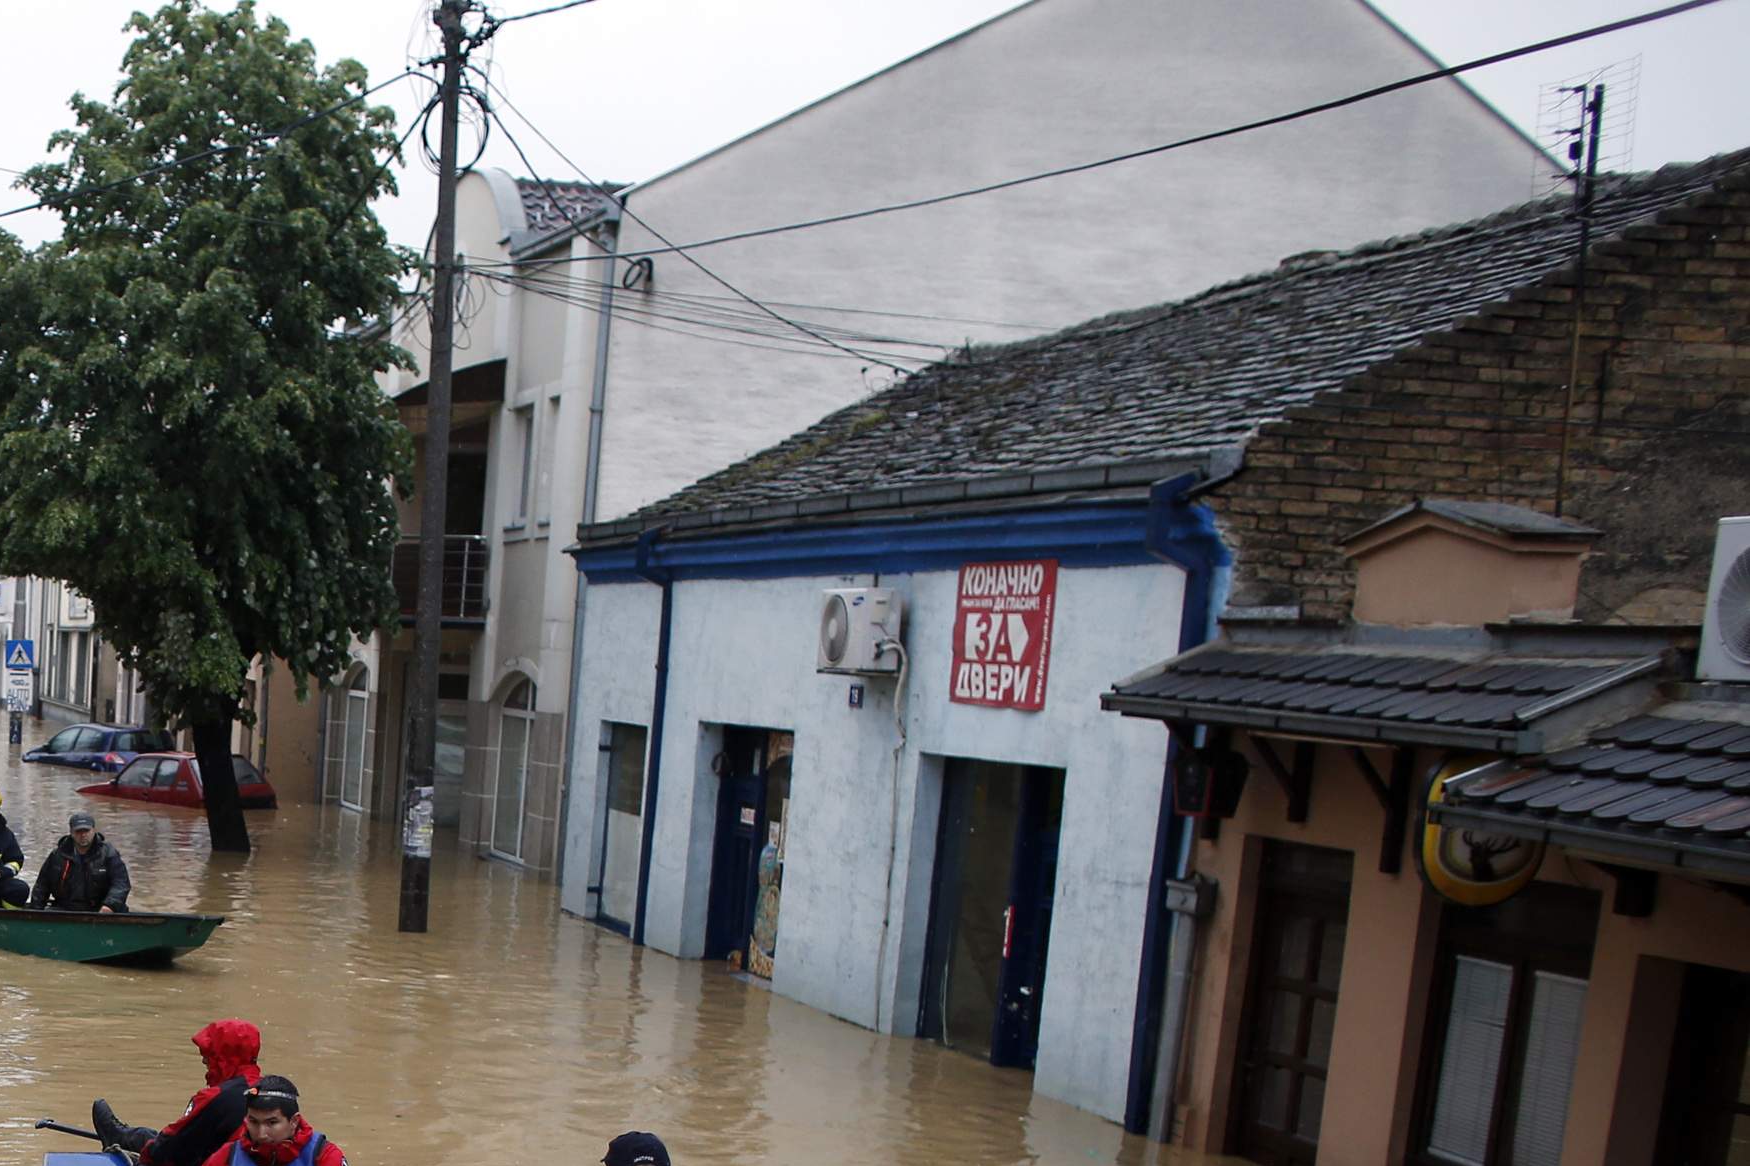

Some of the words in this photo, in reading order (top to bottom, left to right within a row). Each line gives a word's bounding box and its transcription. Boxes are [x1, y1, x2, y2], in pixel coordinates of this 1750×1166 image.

[962, 564, 1044, 595] КОНАЧНО
[967, 612, 1022, 662] ЗА
[955, 662, 1031, 703] ДВЕРИ
